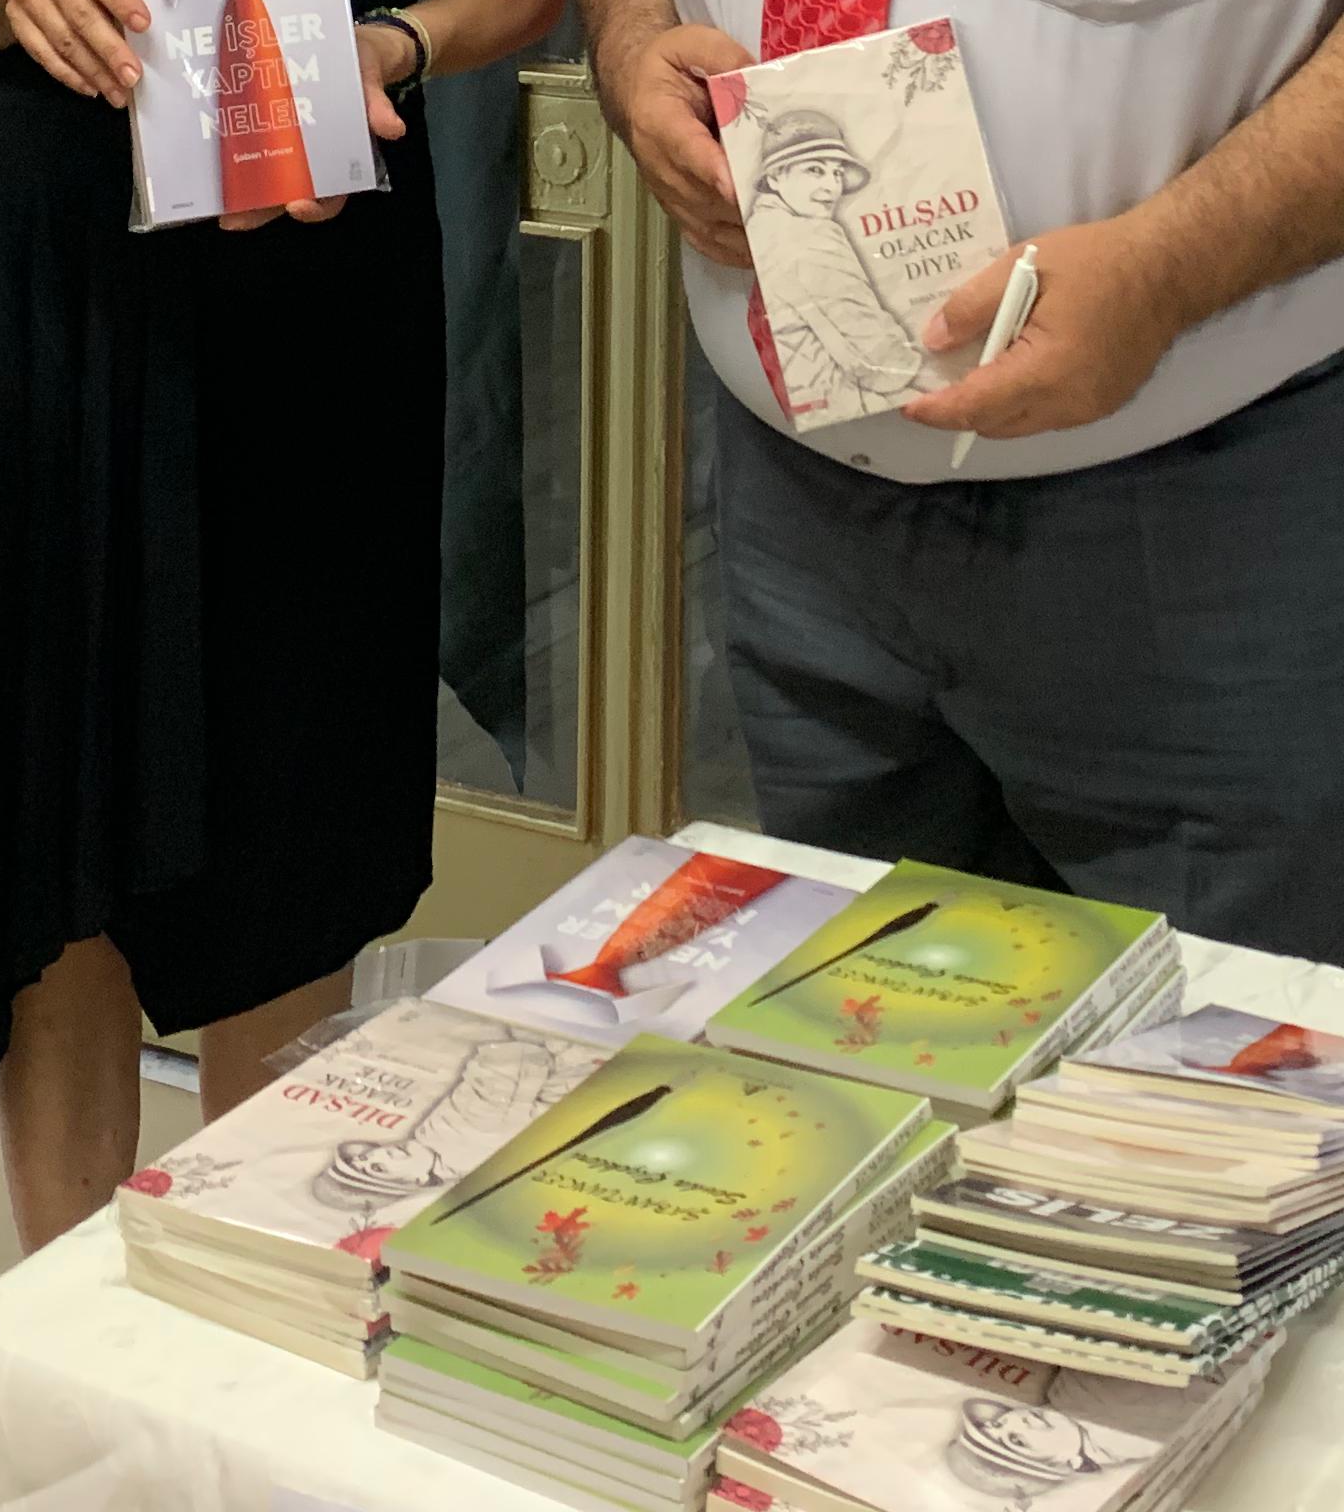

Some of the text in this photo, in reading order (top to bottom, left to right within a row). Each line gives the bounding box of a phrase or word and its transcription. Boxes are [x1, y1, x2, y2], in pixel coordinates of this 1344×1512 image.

[165, 11, 326, 61] NE İŞLER
[182, 53, 321, 100] YAPTIM
[199, 96, 317, 140] NELER
[859, 187, 981, 239] DİLŞAD
[878, 220, 976, 262] OLACAK
[904, 250, 962, 281] DİYE
